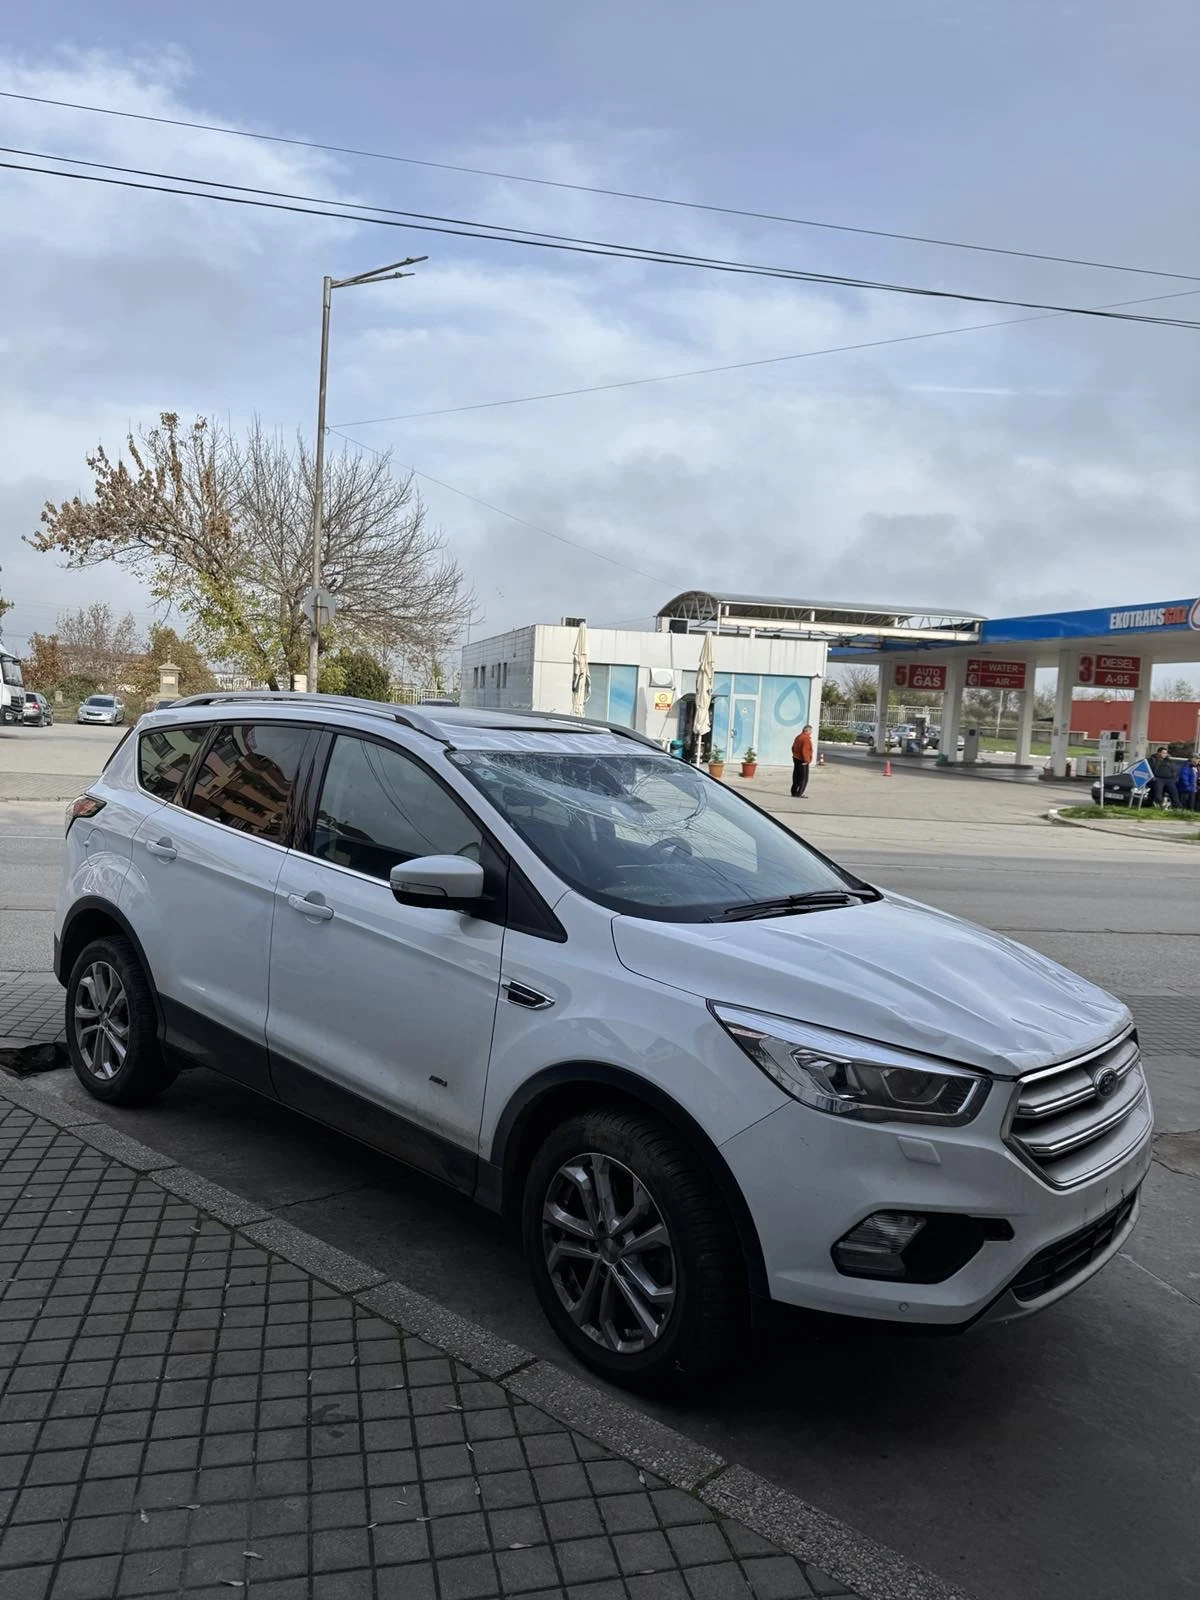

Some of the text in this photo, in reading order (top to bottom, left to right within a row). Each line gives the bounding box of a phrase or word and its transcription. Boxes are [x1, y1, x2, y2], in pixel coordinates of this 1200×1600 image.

[988, 663, 1019, 673] WATER
[1100, 657, 1136, 669] DIESEL
[915, 667, 940, 676] AUTO
[912, 675, 942, 688] GAS
[994, 676, 1011, 686] AIR
